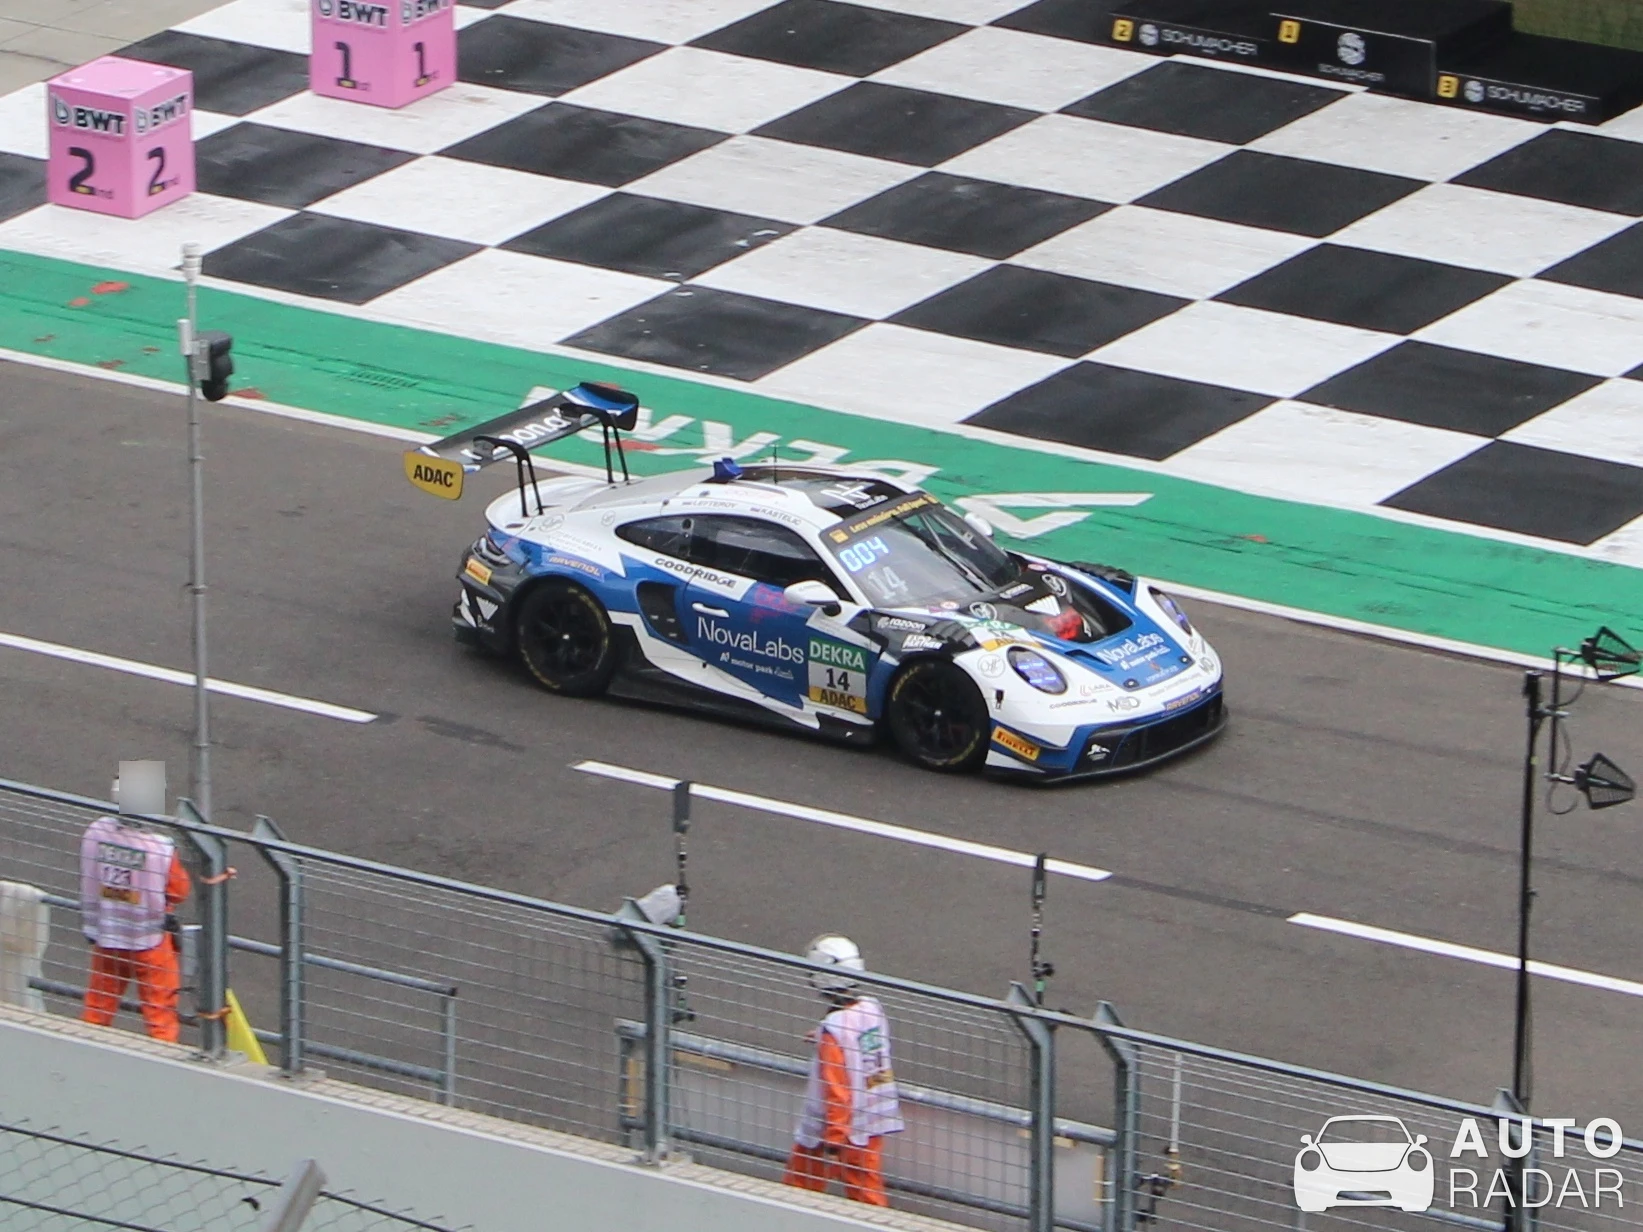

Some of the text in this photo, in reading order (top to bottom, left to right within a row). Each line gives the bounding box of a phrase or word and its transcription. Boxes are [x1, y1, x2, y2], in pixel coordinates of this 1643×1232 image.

[340, 0, 388, 27] BWT
[1161, 29, 1258, 55] SCHUMACHER
[1487, 85, 1586, 112] SCHUMACHER
[74, 107, 125, 135] BWT
[413, 465, 454, 488] ADAC
[867, 566, 909, 600] 14
[889, 618, 926, 632] razoon
[697, 615, 805, 666] NovaLabs
[1096, 632, 1165, 665] NovaLabs
[808, 639, 866, 671] DEKRA
[825, 667, 850, 692] 14
[819, 688, 857, 709] ADAC
[996, 730, 1037, 756] PIRELLI
